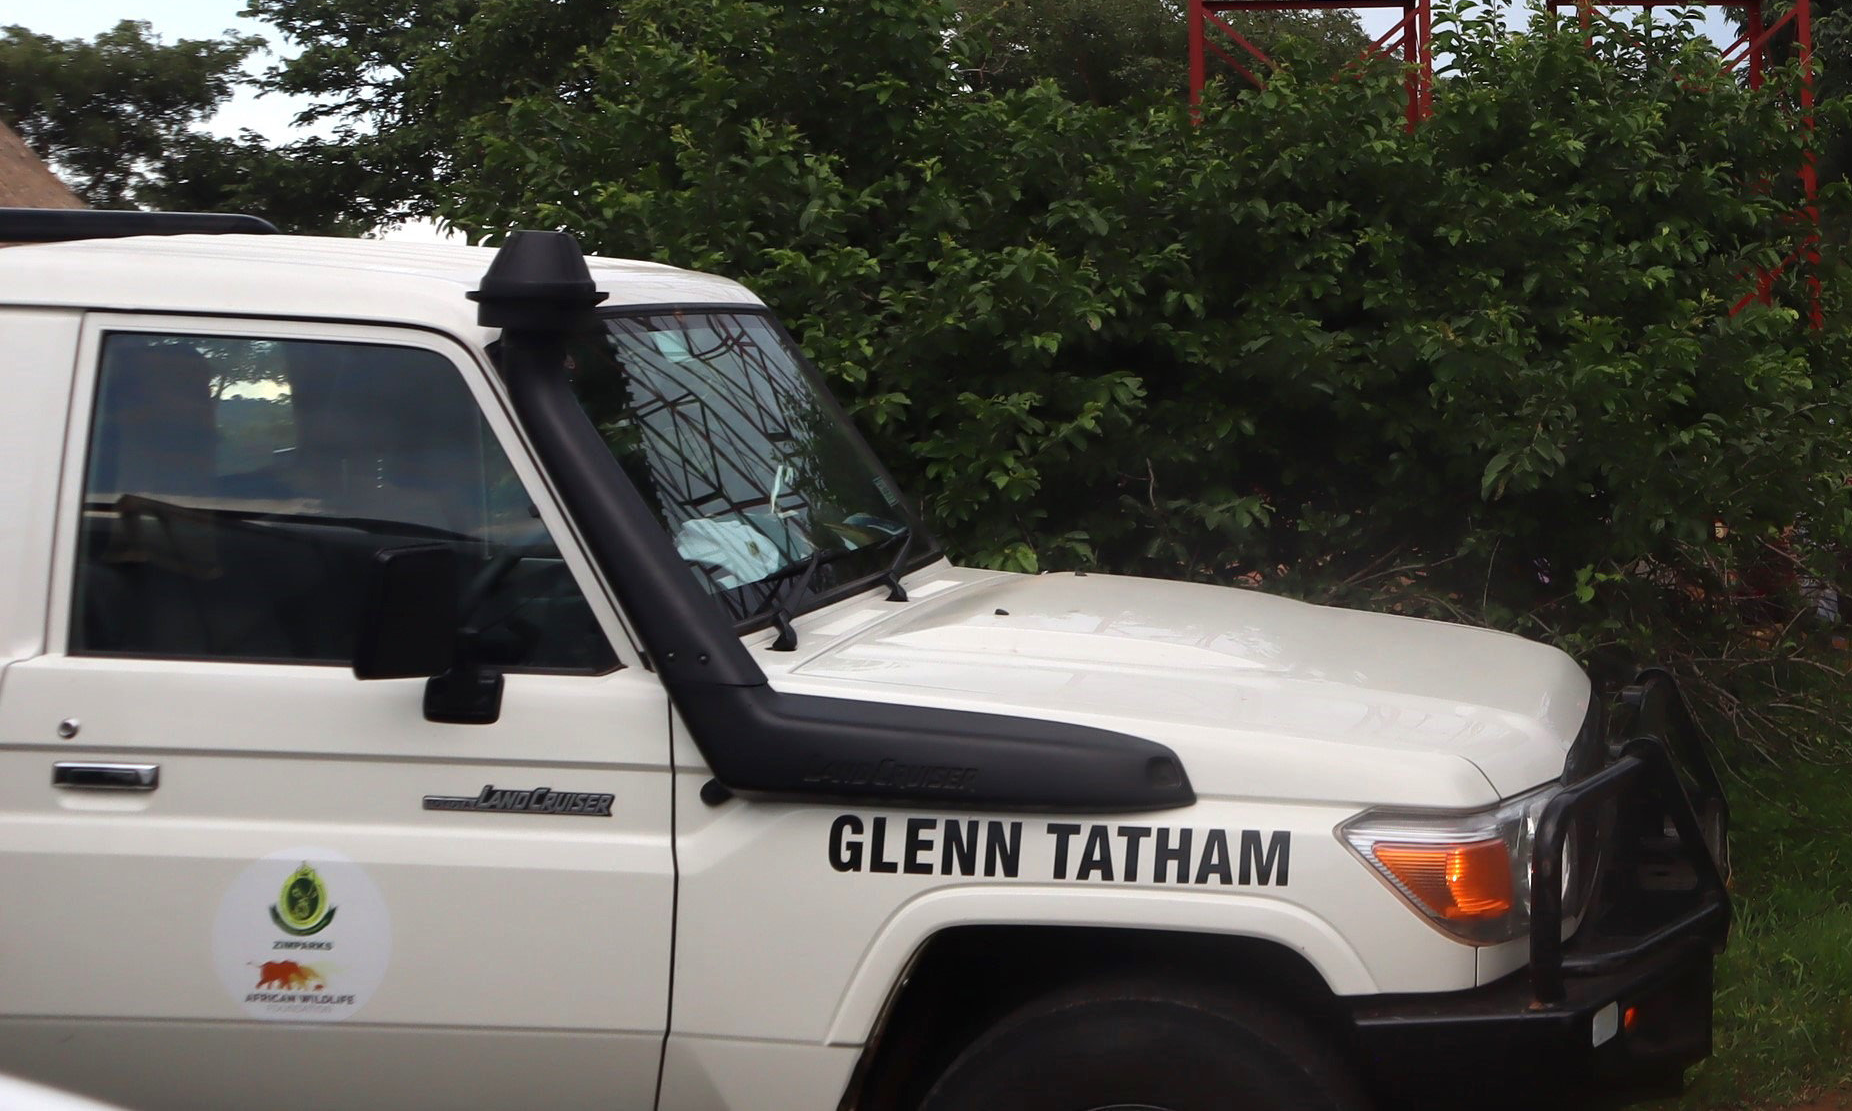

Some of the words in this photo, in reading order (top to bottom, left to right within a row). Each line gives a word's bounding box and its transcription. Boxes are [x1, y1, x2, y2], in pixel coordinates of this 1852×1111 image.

[828, 814, 1022, 877] GLENN
[1047, 823, 1291, 886] TATHAM
[272, 941, 334, 951] ZIMPARKS
[245, 993, 296, 1004] AFRICAN
[301, 994, 355, 1005] WILDLIFE
